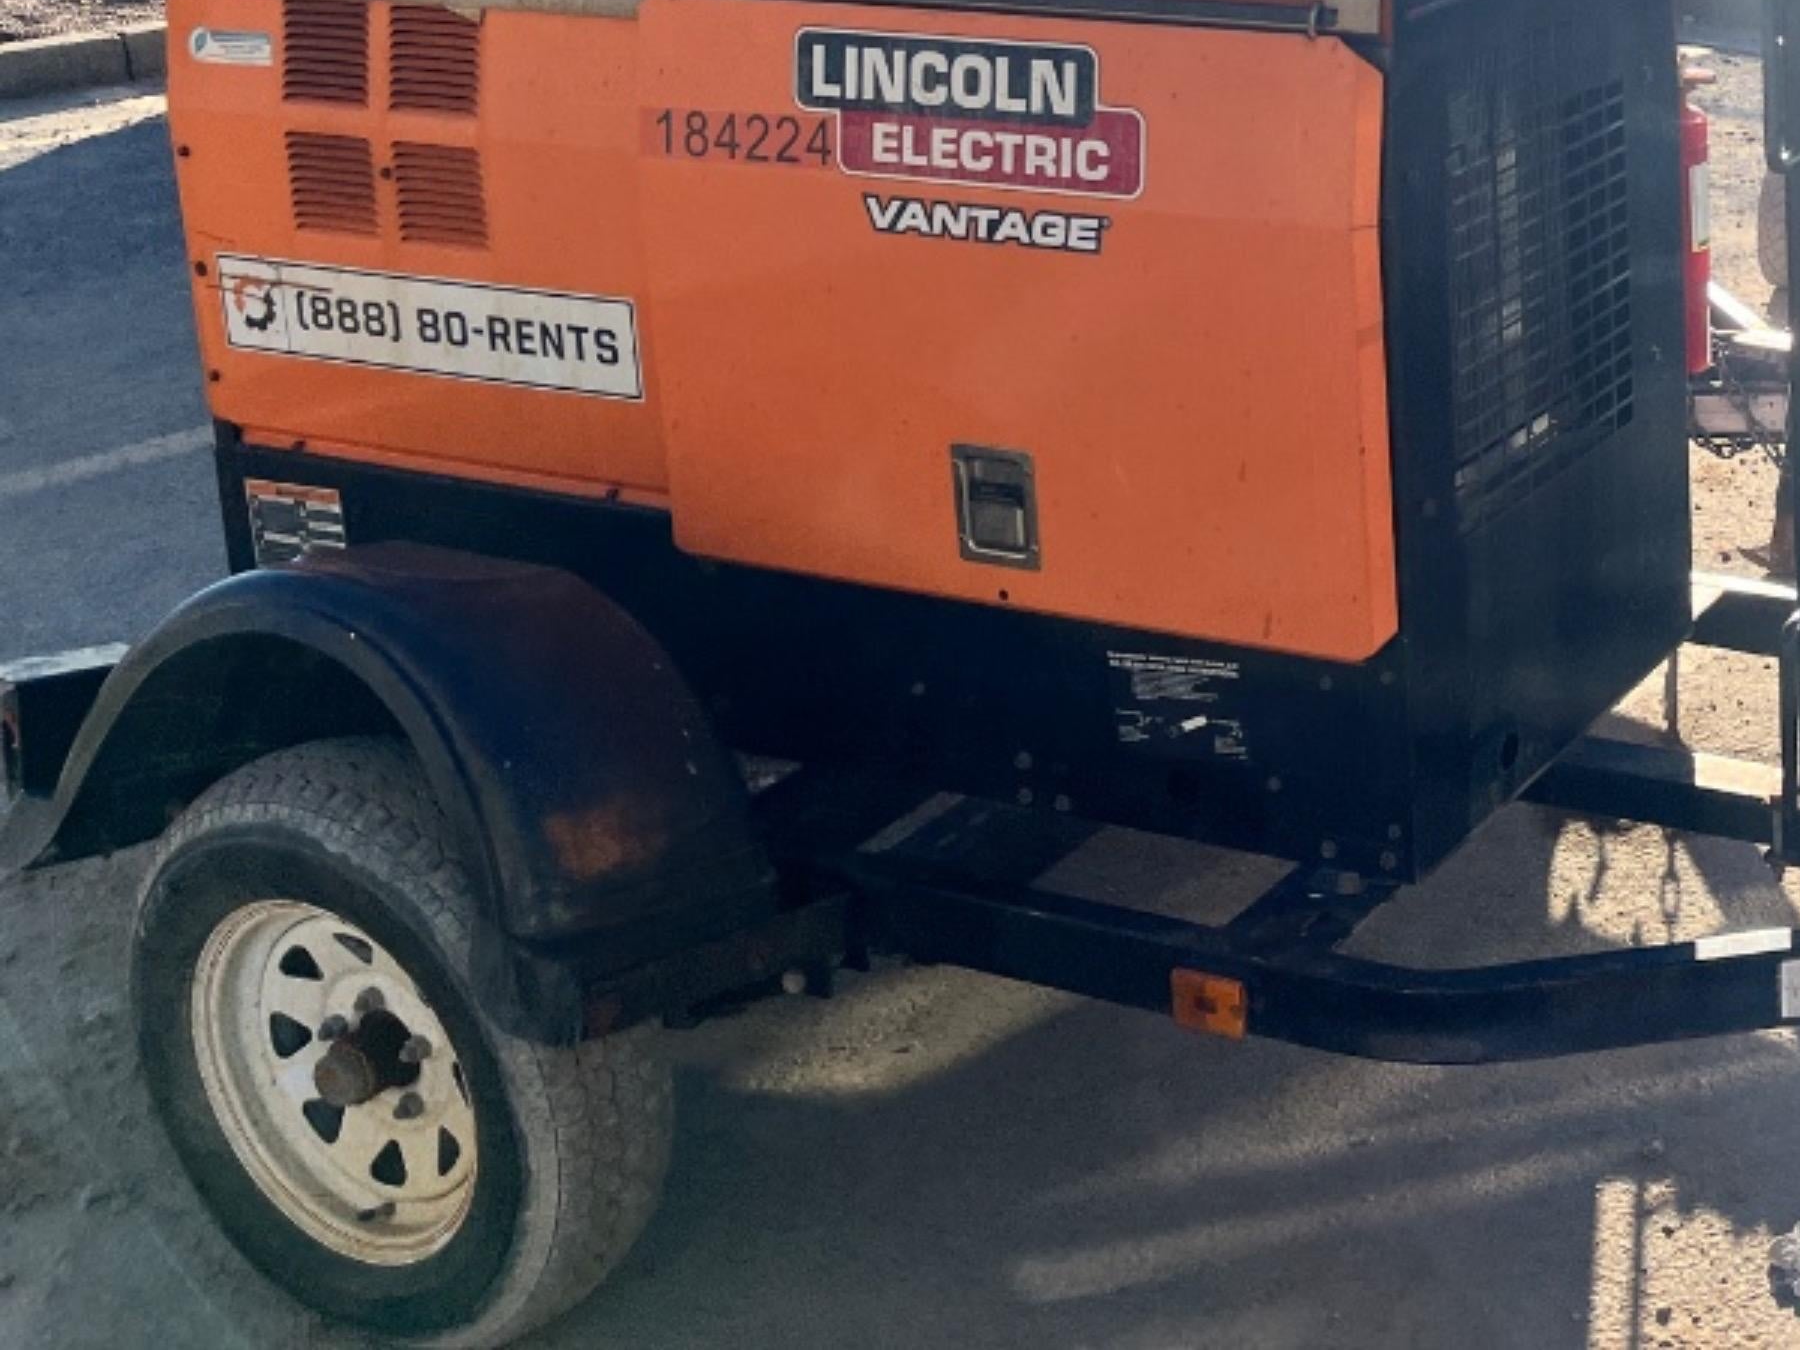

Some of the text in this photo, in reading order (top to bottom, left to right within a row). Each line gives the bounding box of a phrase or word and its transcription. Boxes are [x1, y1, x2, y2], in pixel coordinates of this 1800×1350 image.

[811, 44, 1077, 116] LINCOLN
[655, 108, 833, 167] 184224
[872, 122, 1111, 182] ELECTRIC
[864, 195, 1100, 251] VANTAGE
[296, 291, 619, 367] (888) 80-RENTS
